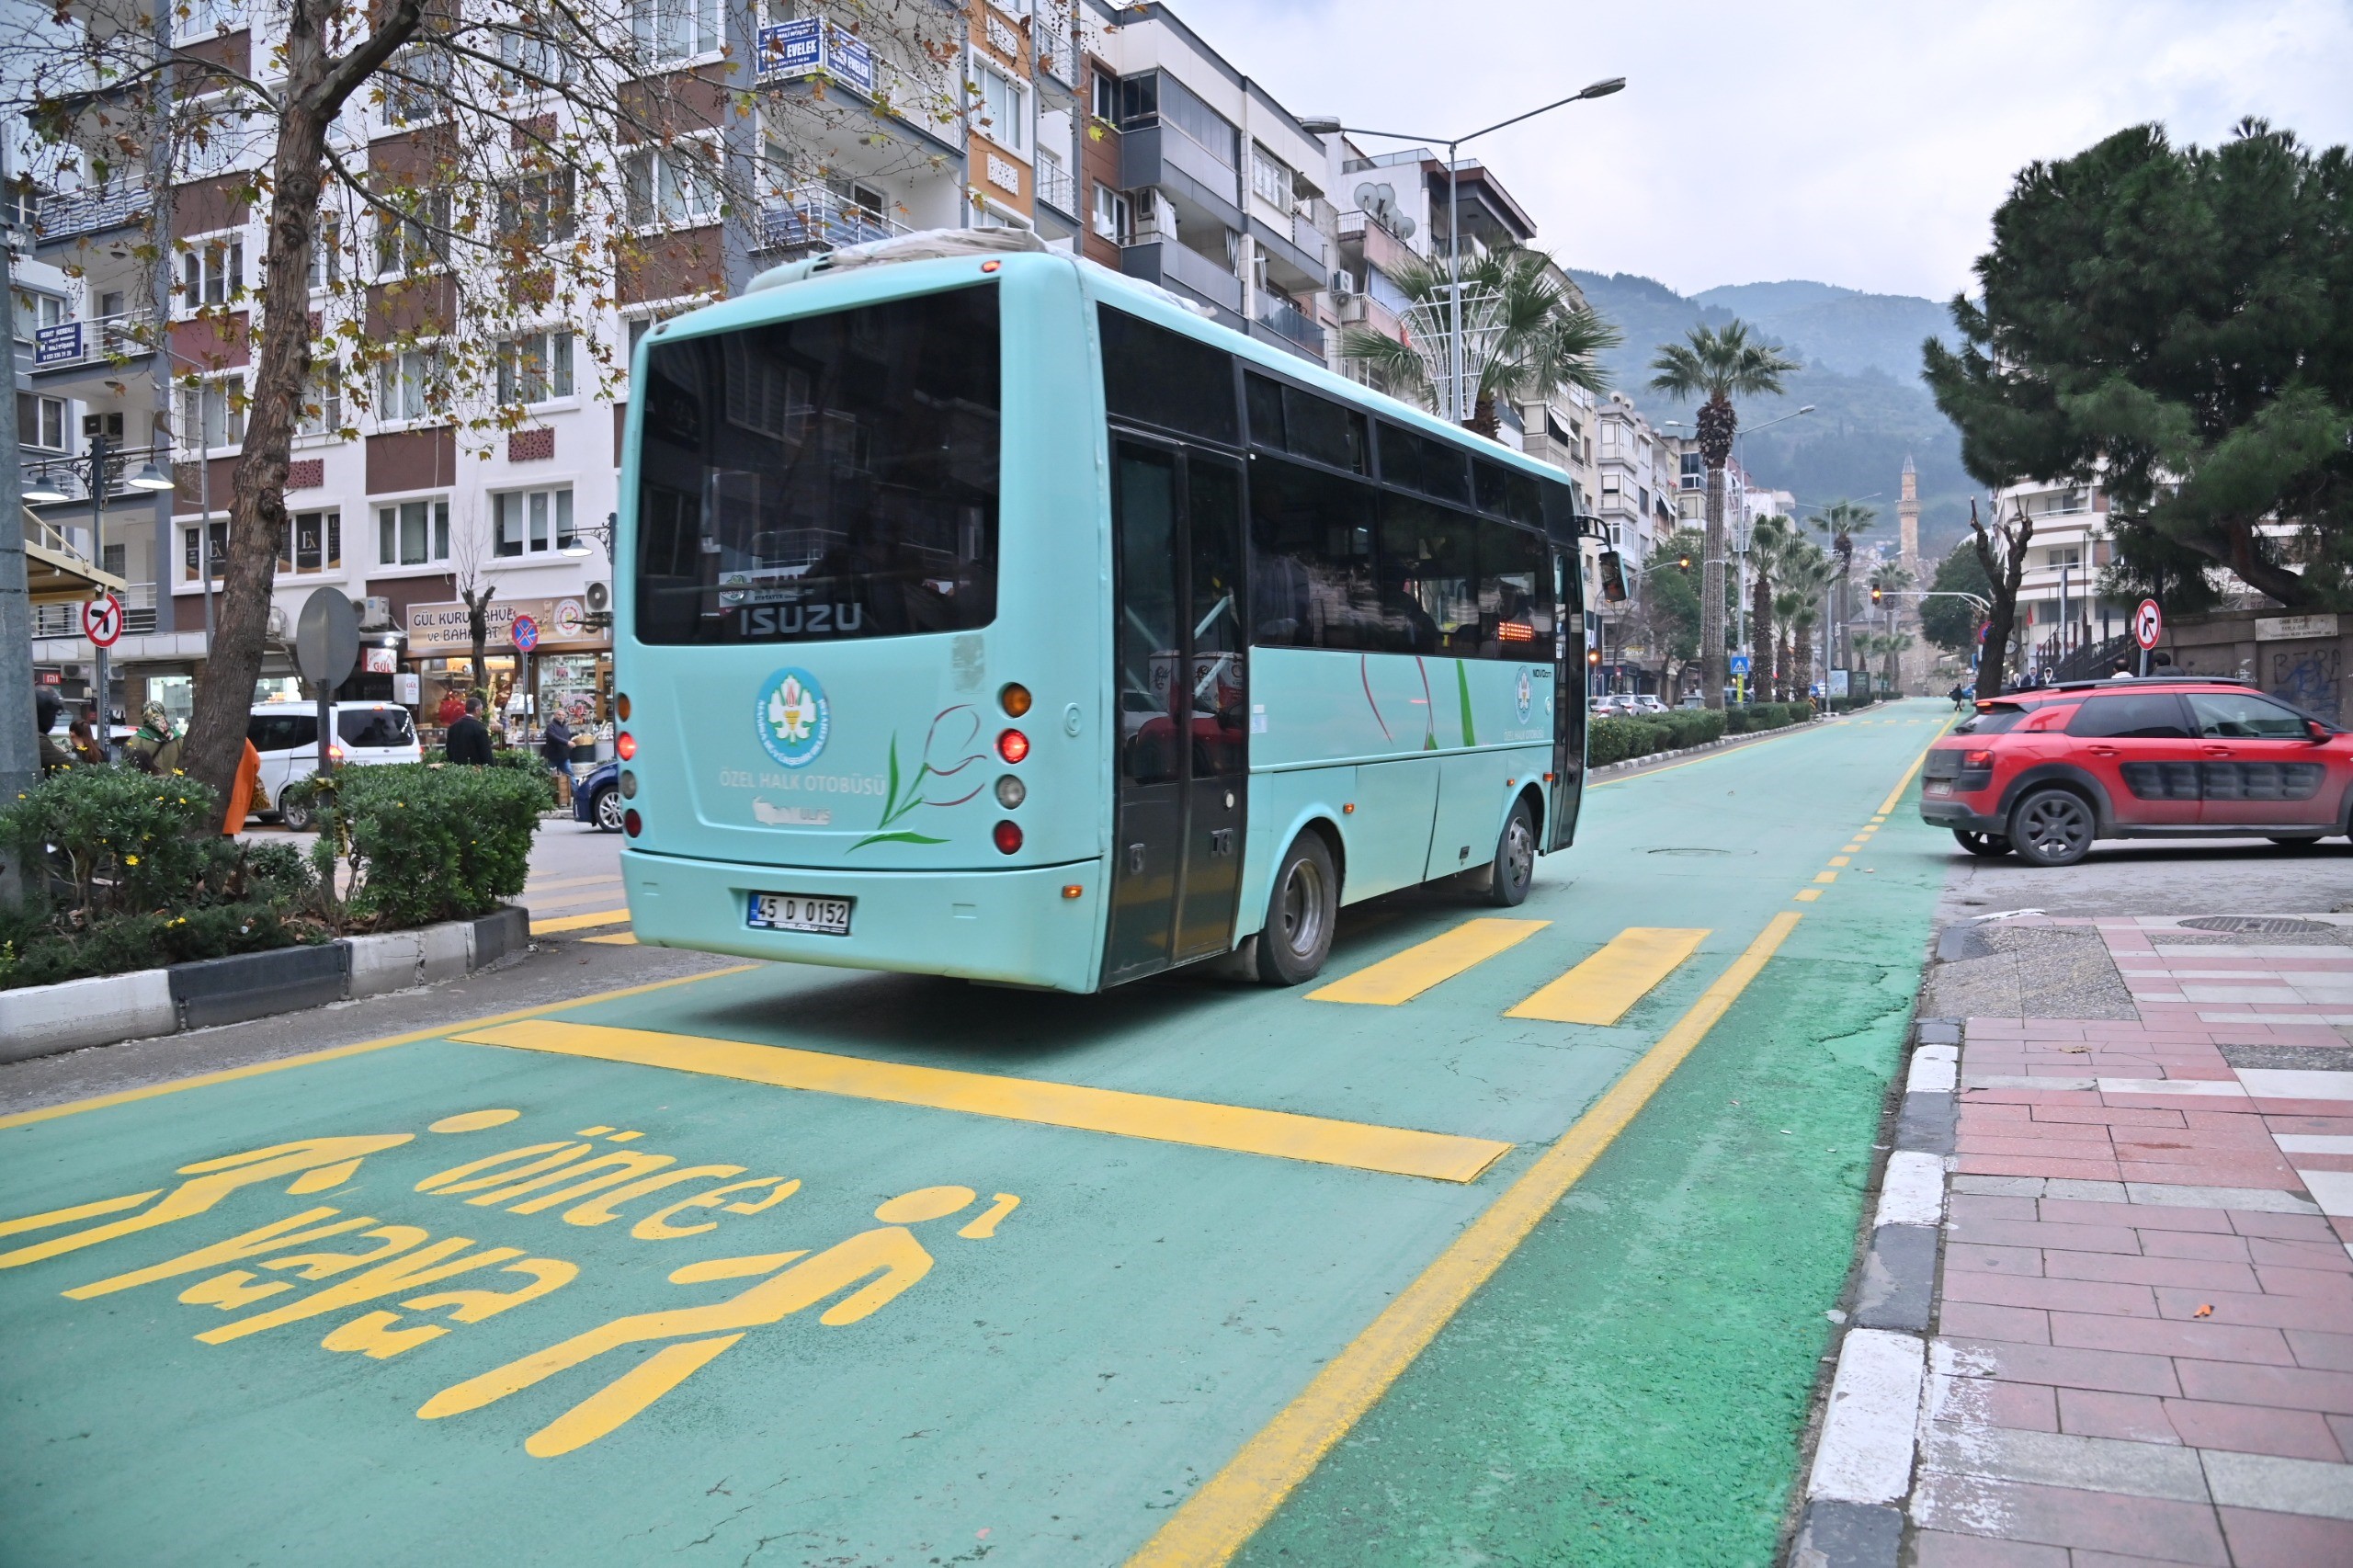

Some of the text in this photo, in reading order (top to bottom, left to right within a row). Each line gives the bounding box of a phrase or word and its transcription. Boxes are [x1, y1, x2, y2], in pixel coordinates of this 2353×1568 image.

[787, 40, 817, 58] EVELEK
[414, 611, 436, 627] GÜL
[740, 602, 862, 636] ISUZU
[427, 631, 439, 642] ve
[373, 661, 392, 673] GÜL
[719, 767, 886, 796] ÖZEL HALK OTOBÜSÜ
[757, 897, 846, 924] 45 D 0152
[60, 1205, 581, 1360] yaya
